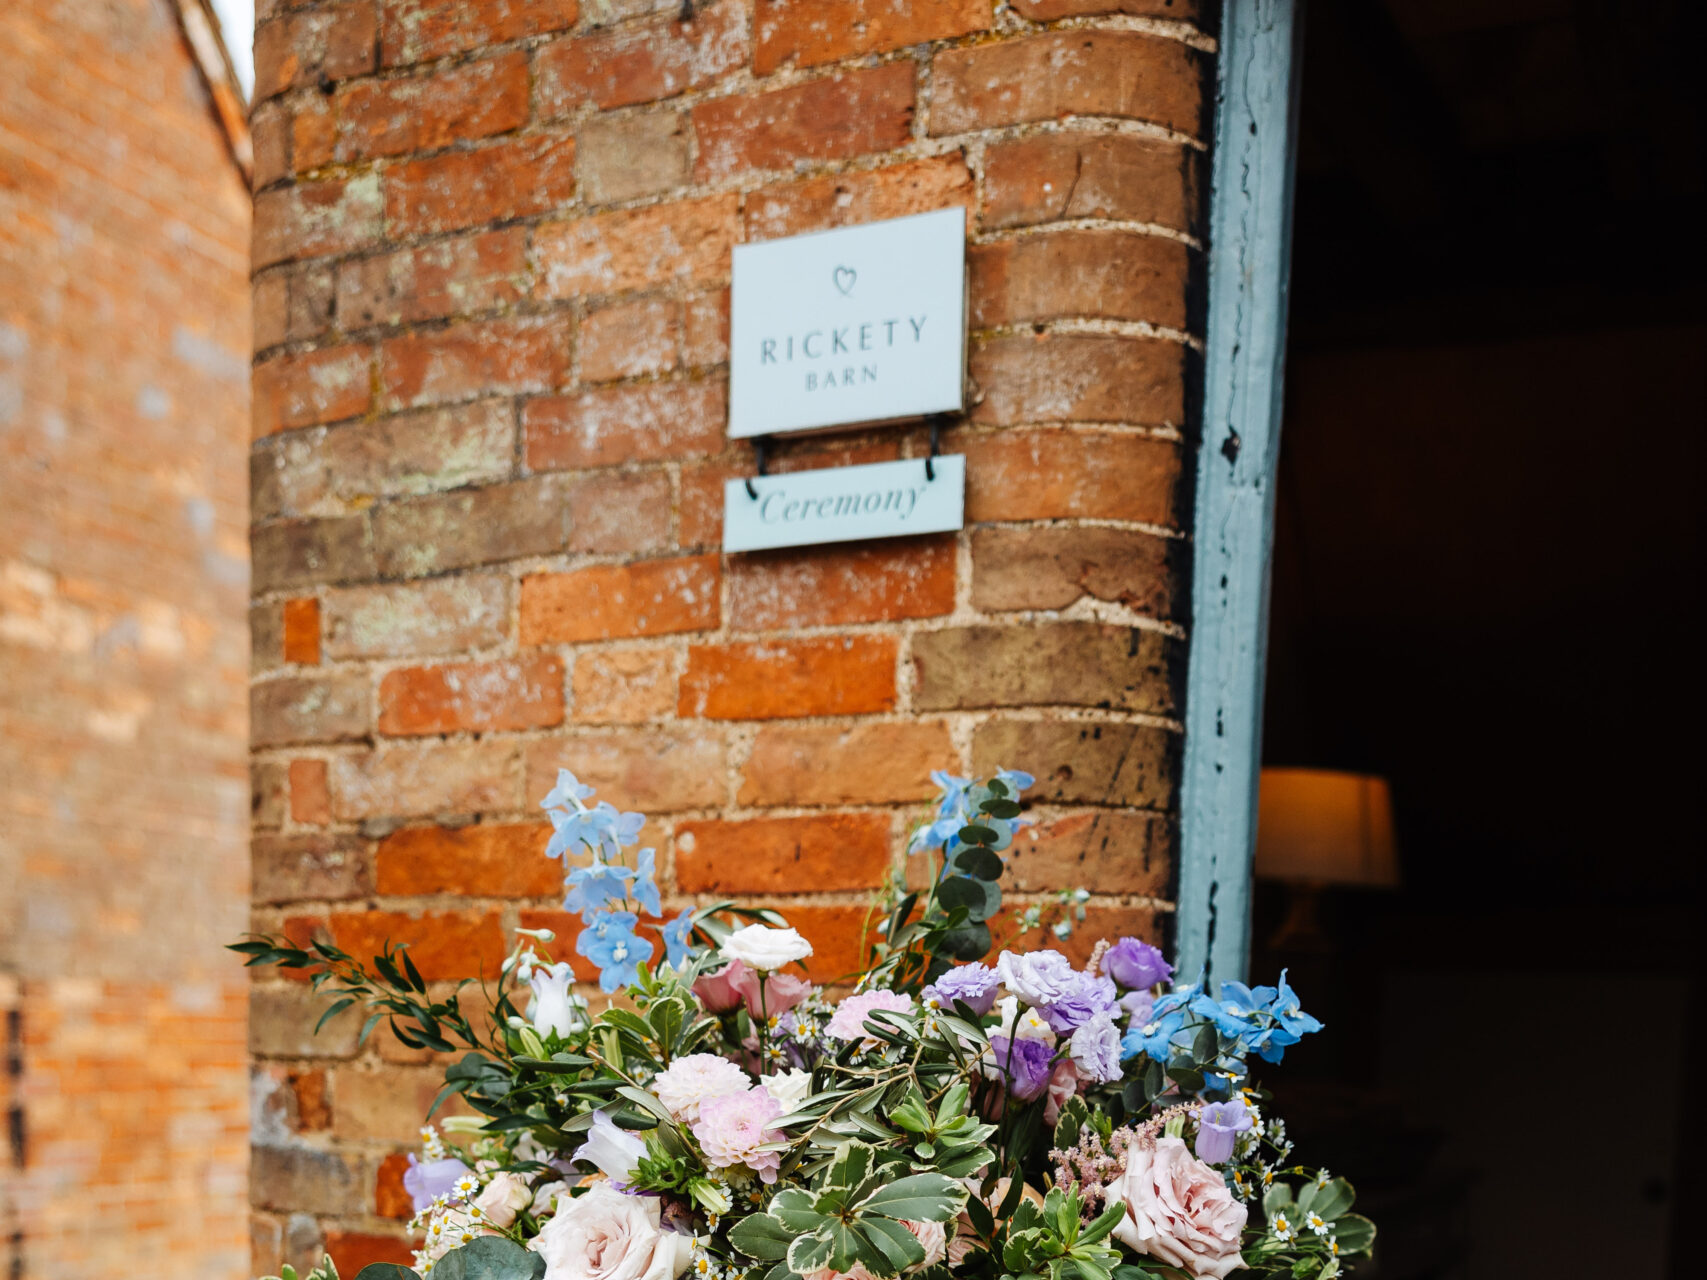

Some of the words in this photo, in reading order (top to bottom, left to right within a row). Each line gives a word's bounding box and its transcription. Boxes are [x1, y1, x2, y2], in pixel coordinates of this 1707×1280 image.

[760, 315, 928, 365] RICKETY
[805, 364, 878, 392] BARN
[759, 482, 926, 525] Ceremony
